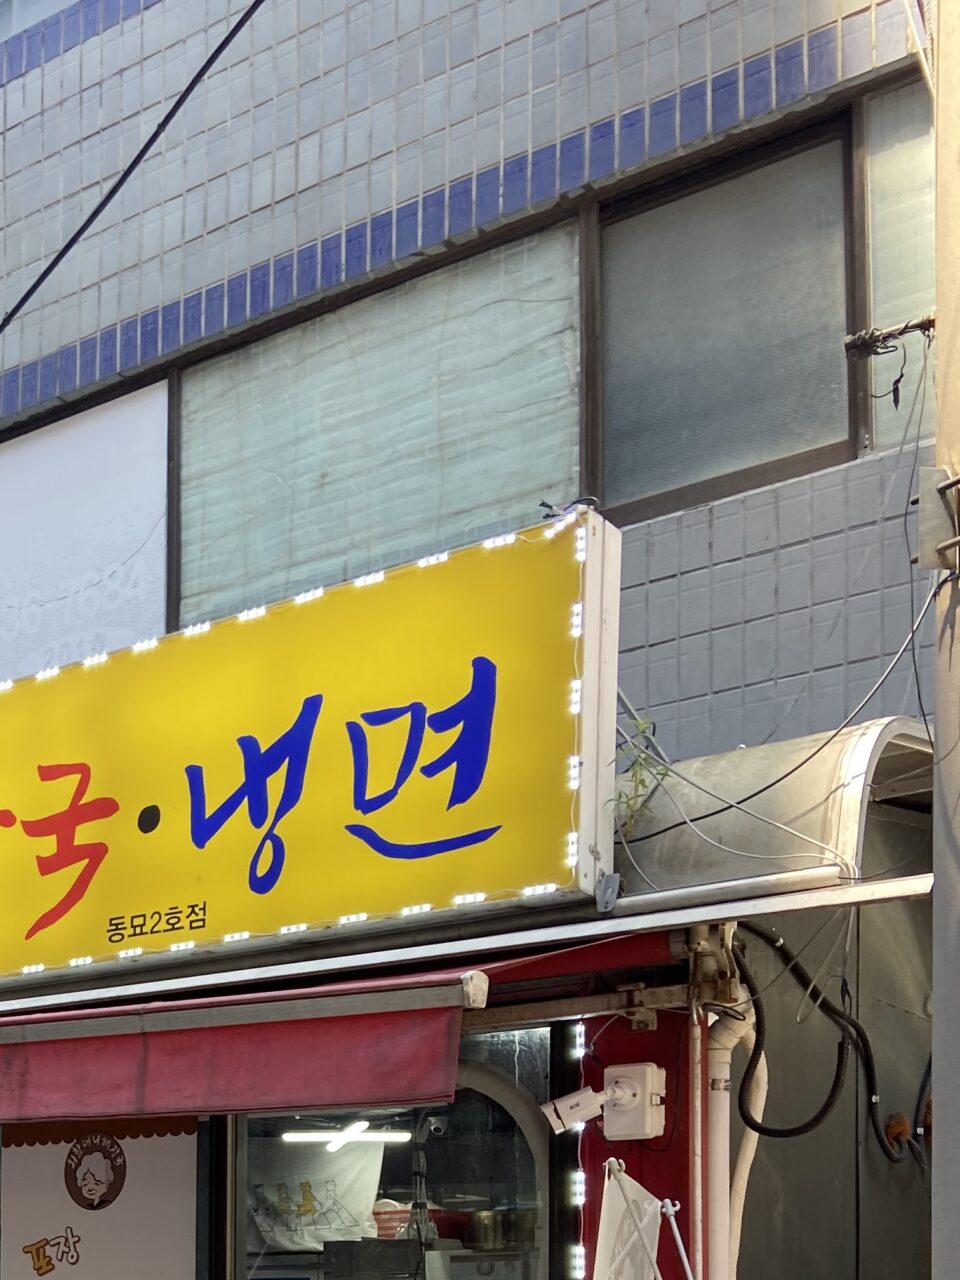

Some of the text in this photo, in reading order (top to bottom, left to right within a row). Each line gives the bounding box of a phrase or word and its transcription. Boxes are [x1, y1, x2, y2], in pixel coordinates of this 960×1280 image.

[186, 657, 497, 894] 냉면
[106, 902, 206, 944] 동묘2호점
[23, 1226, 81, 1276] 포장
